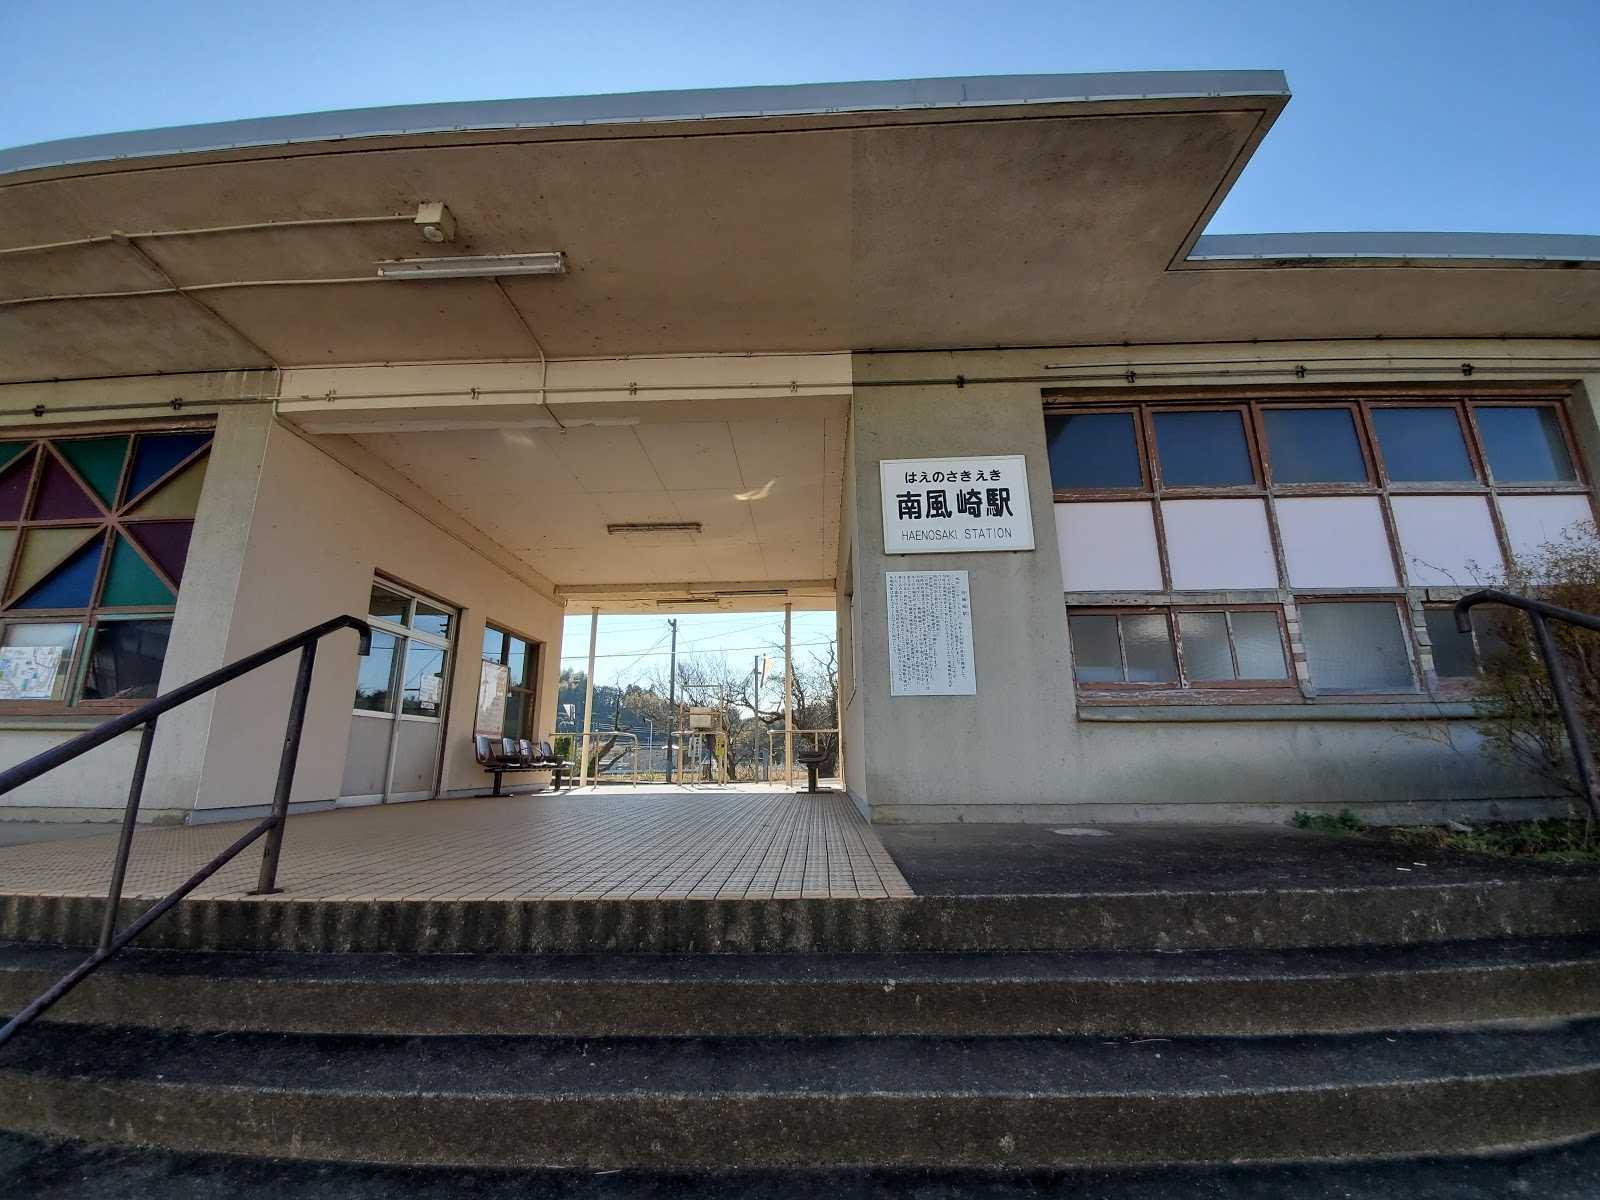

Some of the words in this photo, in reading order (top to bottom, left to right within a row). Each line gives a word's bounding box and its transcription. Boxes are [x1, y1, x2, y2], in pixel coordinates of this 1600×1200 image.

[904, 469, 1001, 484] はえのさきえき
[896, 487, 1014, 520] 南風崎駅
[901, 529, 958, 541] HAENOSAKI
[964, 527, 1012, 540] STATION
